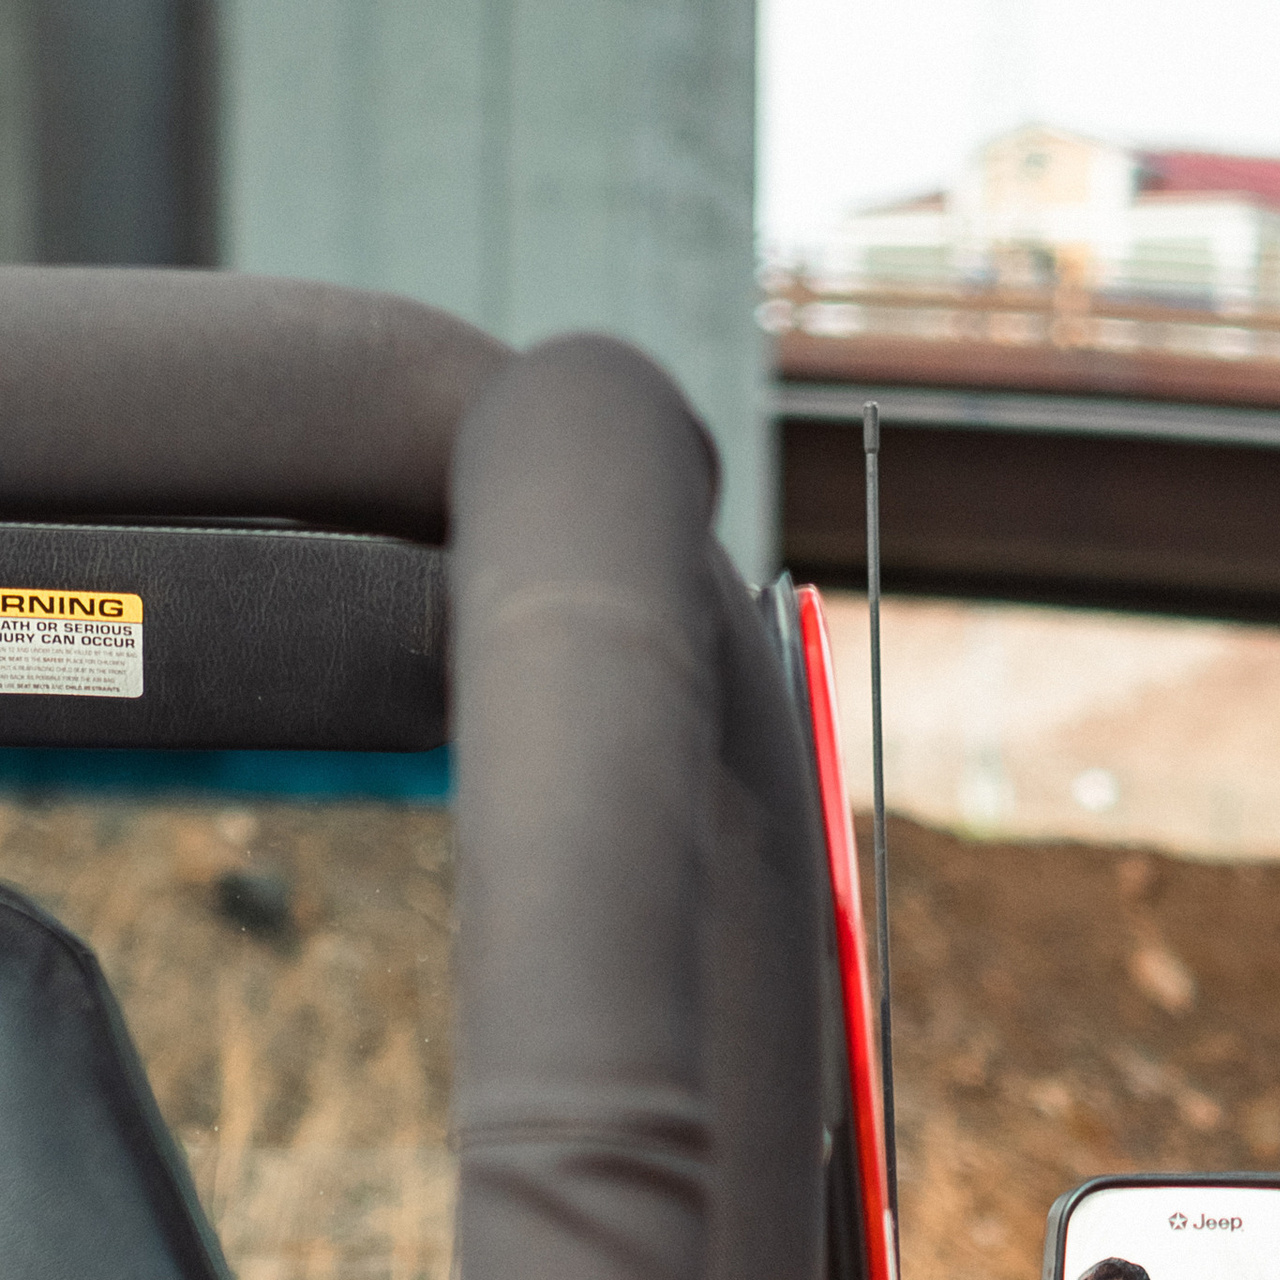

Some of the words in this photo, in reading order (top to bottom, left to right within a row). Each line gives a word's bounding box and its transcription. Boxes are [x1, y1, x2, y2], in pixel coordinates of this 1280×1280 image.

[1, 595, 123, 617] RNING
[1, 620, 30, 631] ATH
[37, 621, 58, 632] OR
[64, 623, 132, 636] SERIOUS
[41, 634, 75, 645] CAN
[81, 636, 135, 648] OCCUR
[1193, 1213, 1243, 1232] Jeep
